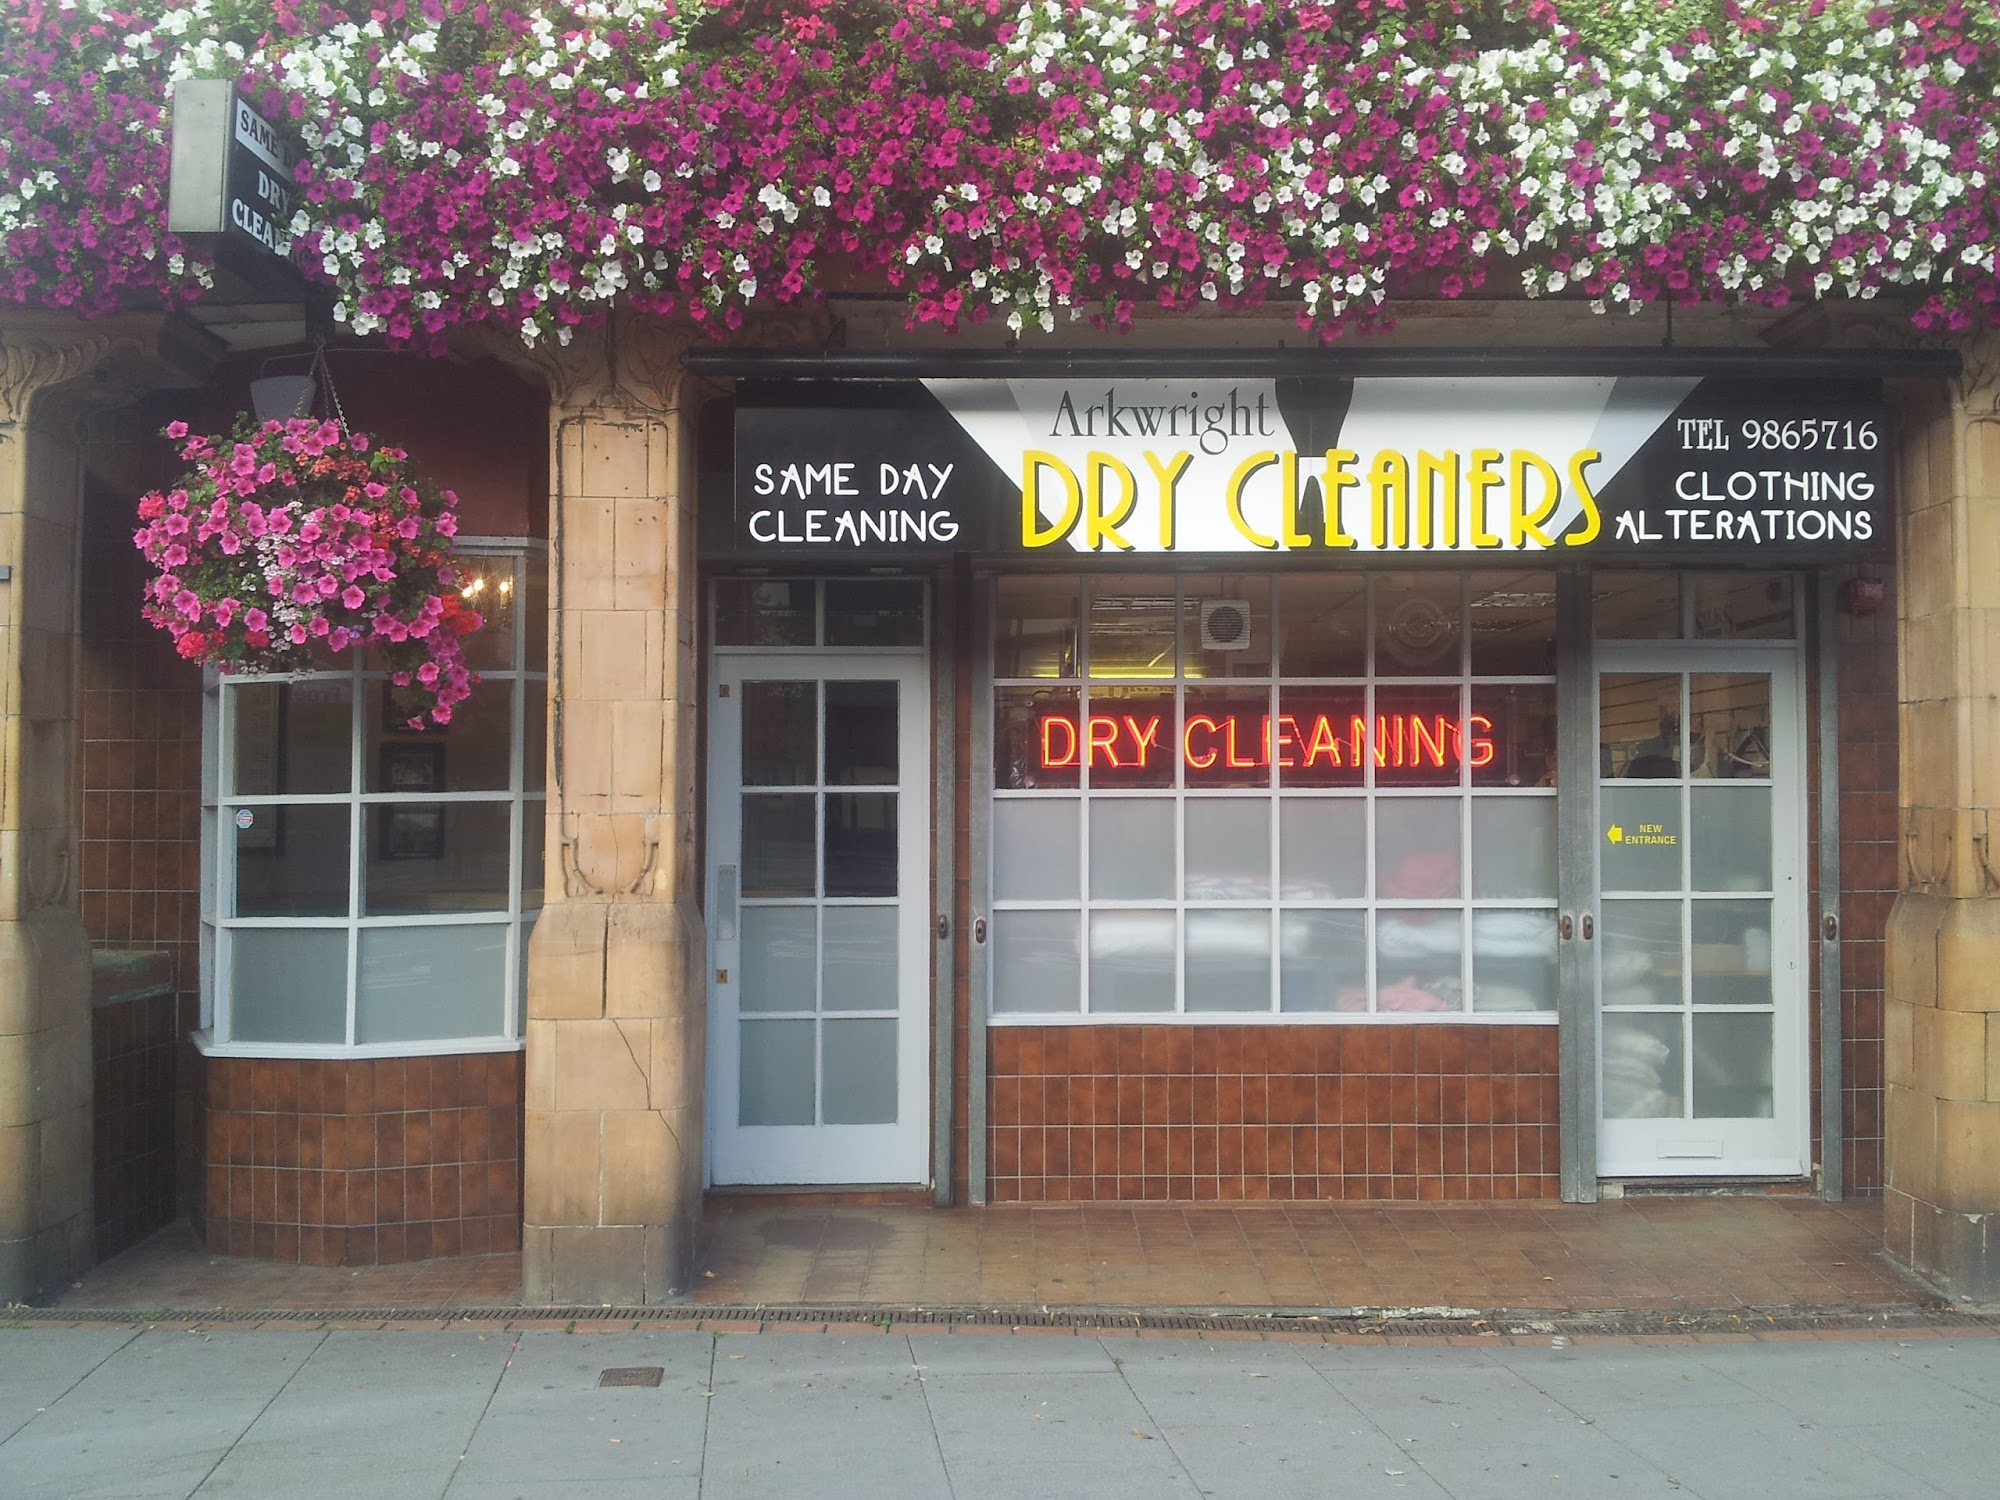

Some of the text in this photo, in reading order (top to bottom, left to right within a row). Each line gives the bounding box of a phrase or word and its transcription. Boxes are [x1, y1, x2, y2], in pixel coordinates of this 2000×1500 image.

[240, 109, 279, 159] SAME
[257, 170, 290, 215] DRY
[1049, 387, 1275, 455] Arkwright
[1677, 418, 1879, 451] TEL 9865716
[754, 462, 955, 500] SAME DAY
[1022, 448, 1604, 550] DRY CLEANERS
[1675, 471, 1875, 501] CLOTHING
[748, 509, 960, 546] CLEANING
[1615, 509, 1874, 545] ALTERATIONS
[1040, 714, 1495, 769] DRY CLEANING
[1625, 835, 1677, 845] ENTRANCE
[1639, 824, 1662, 833] NEW
